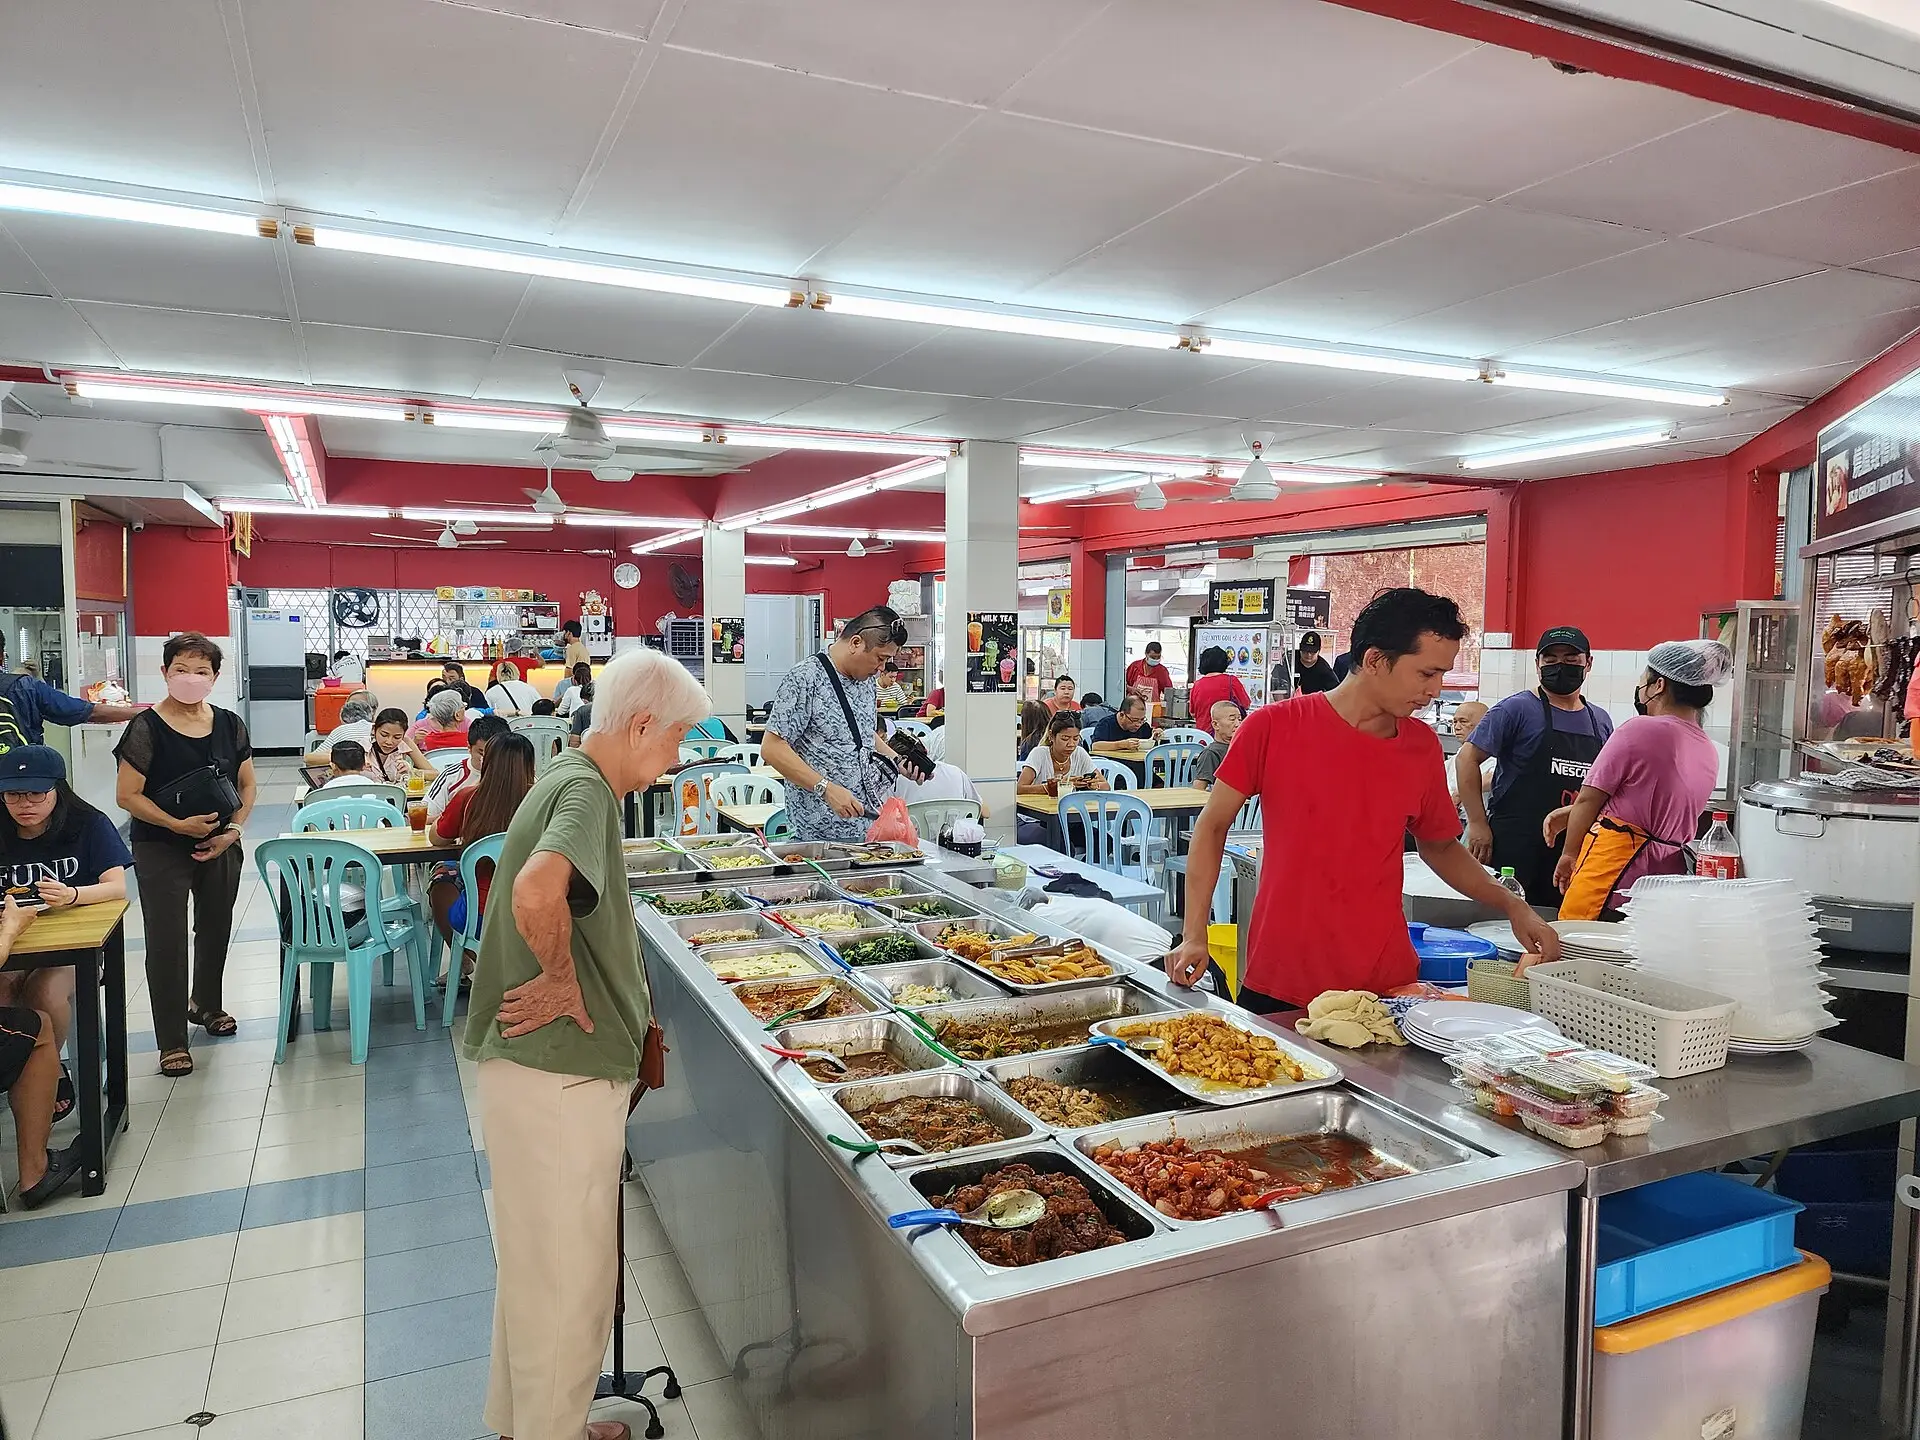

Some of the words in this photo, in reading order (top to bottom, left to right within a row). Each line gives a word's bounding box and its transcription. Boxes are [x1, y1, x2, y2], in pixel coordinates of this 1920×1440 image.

[981, 614, 998, 624] MILK
[1000, 614, 1013, 623] TEA
[1551, 761, 1590, 778] NESCA
